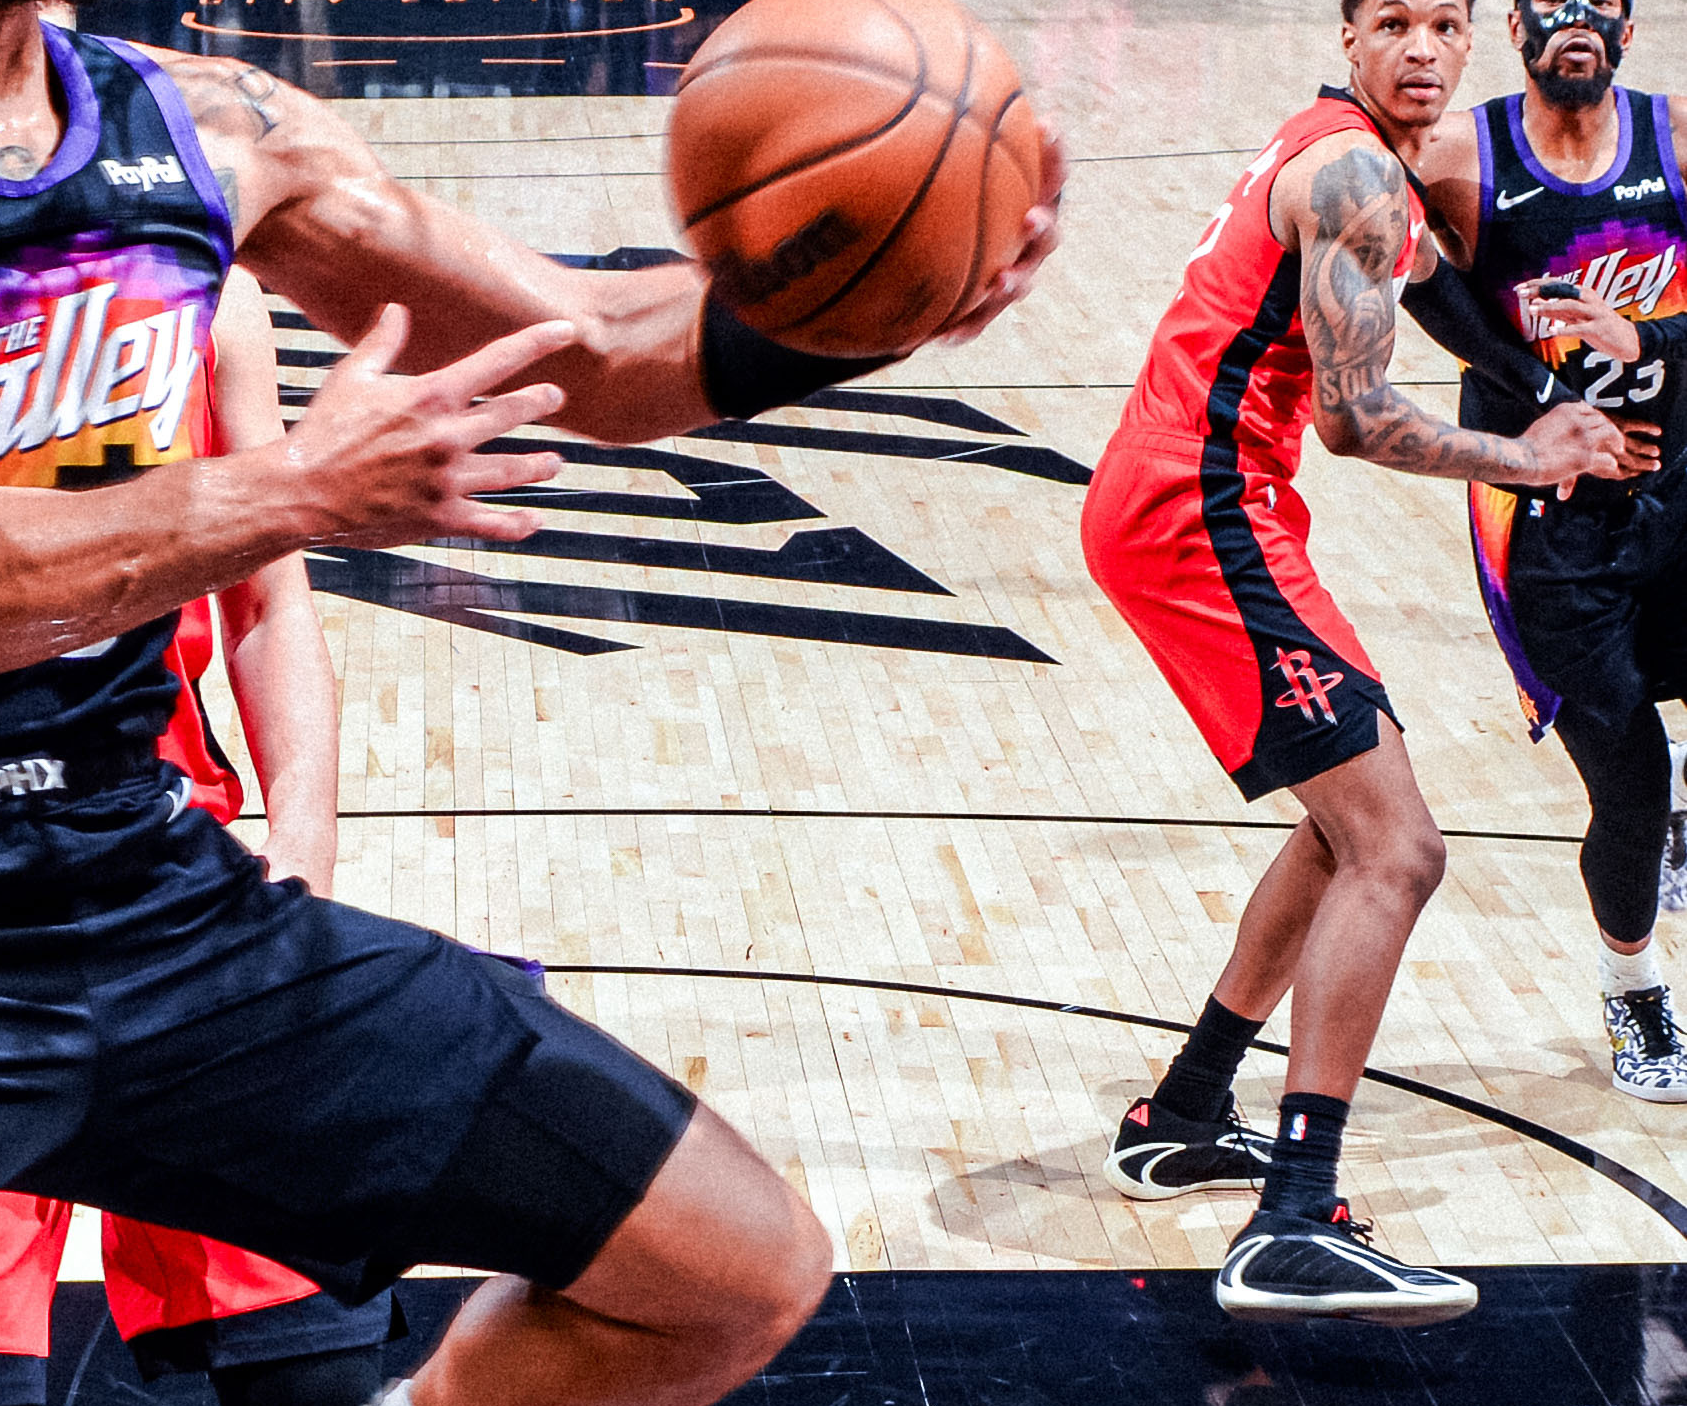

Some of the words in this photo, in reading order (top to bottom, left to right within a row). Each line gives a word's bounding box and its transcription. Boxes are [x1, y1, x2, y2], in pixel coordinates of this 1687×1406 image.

[98, 154, 185, 192] PayPal
[1613, 175, 1666, 201] PayPal
[1583, 350, 1665, 408] 23
